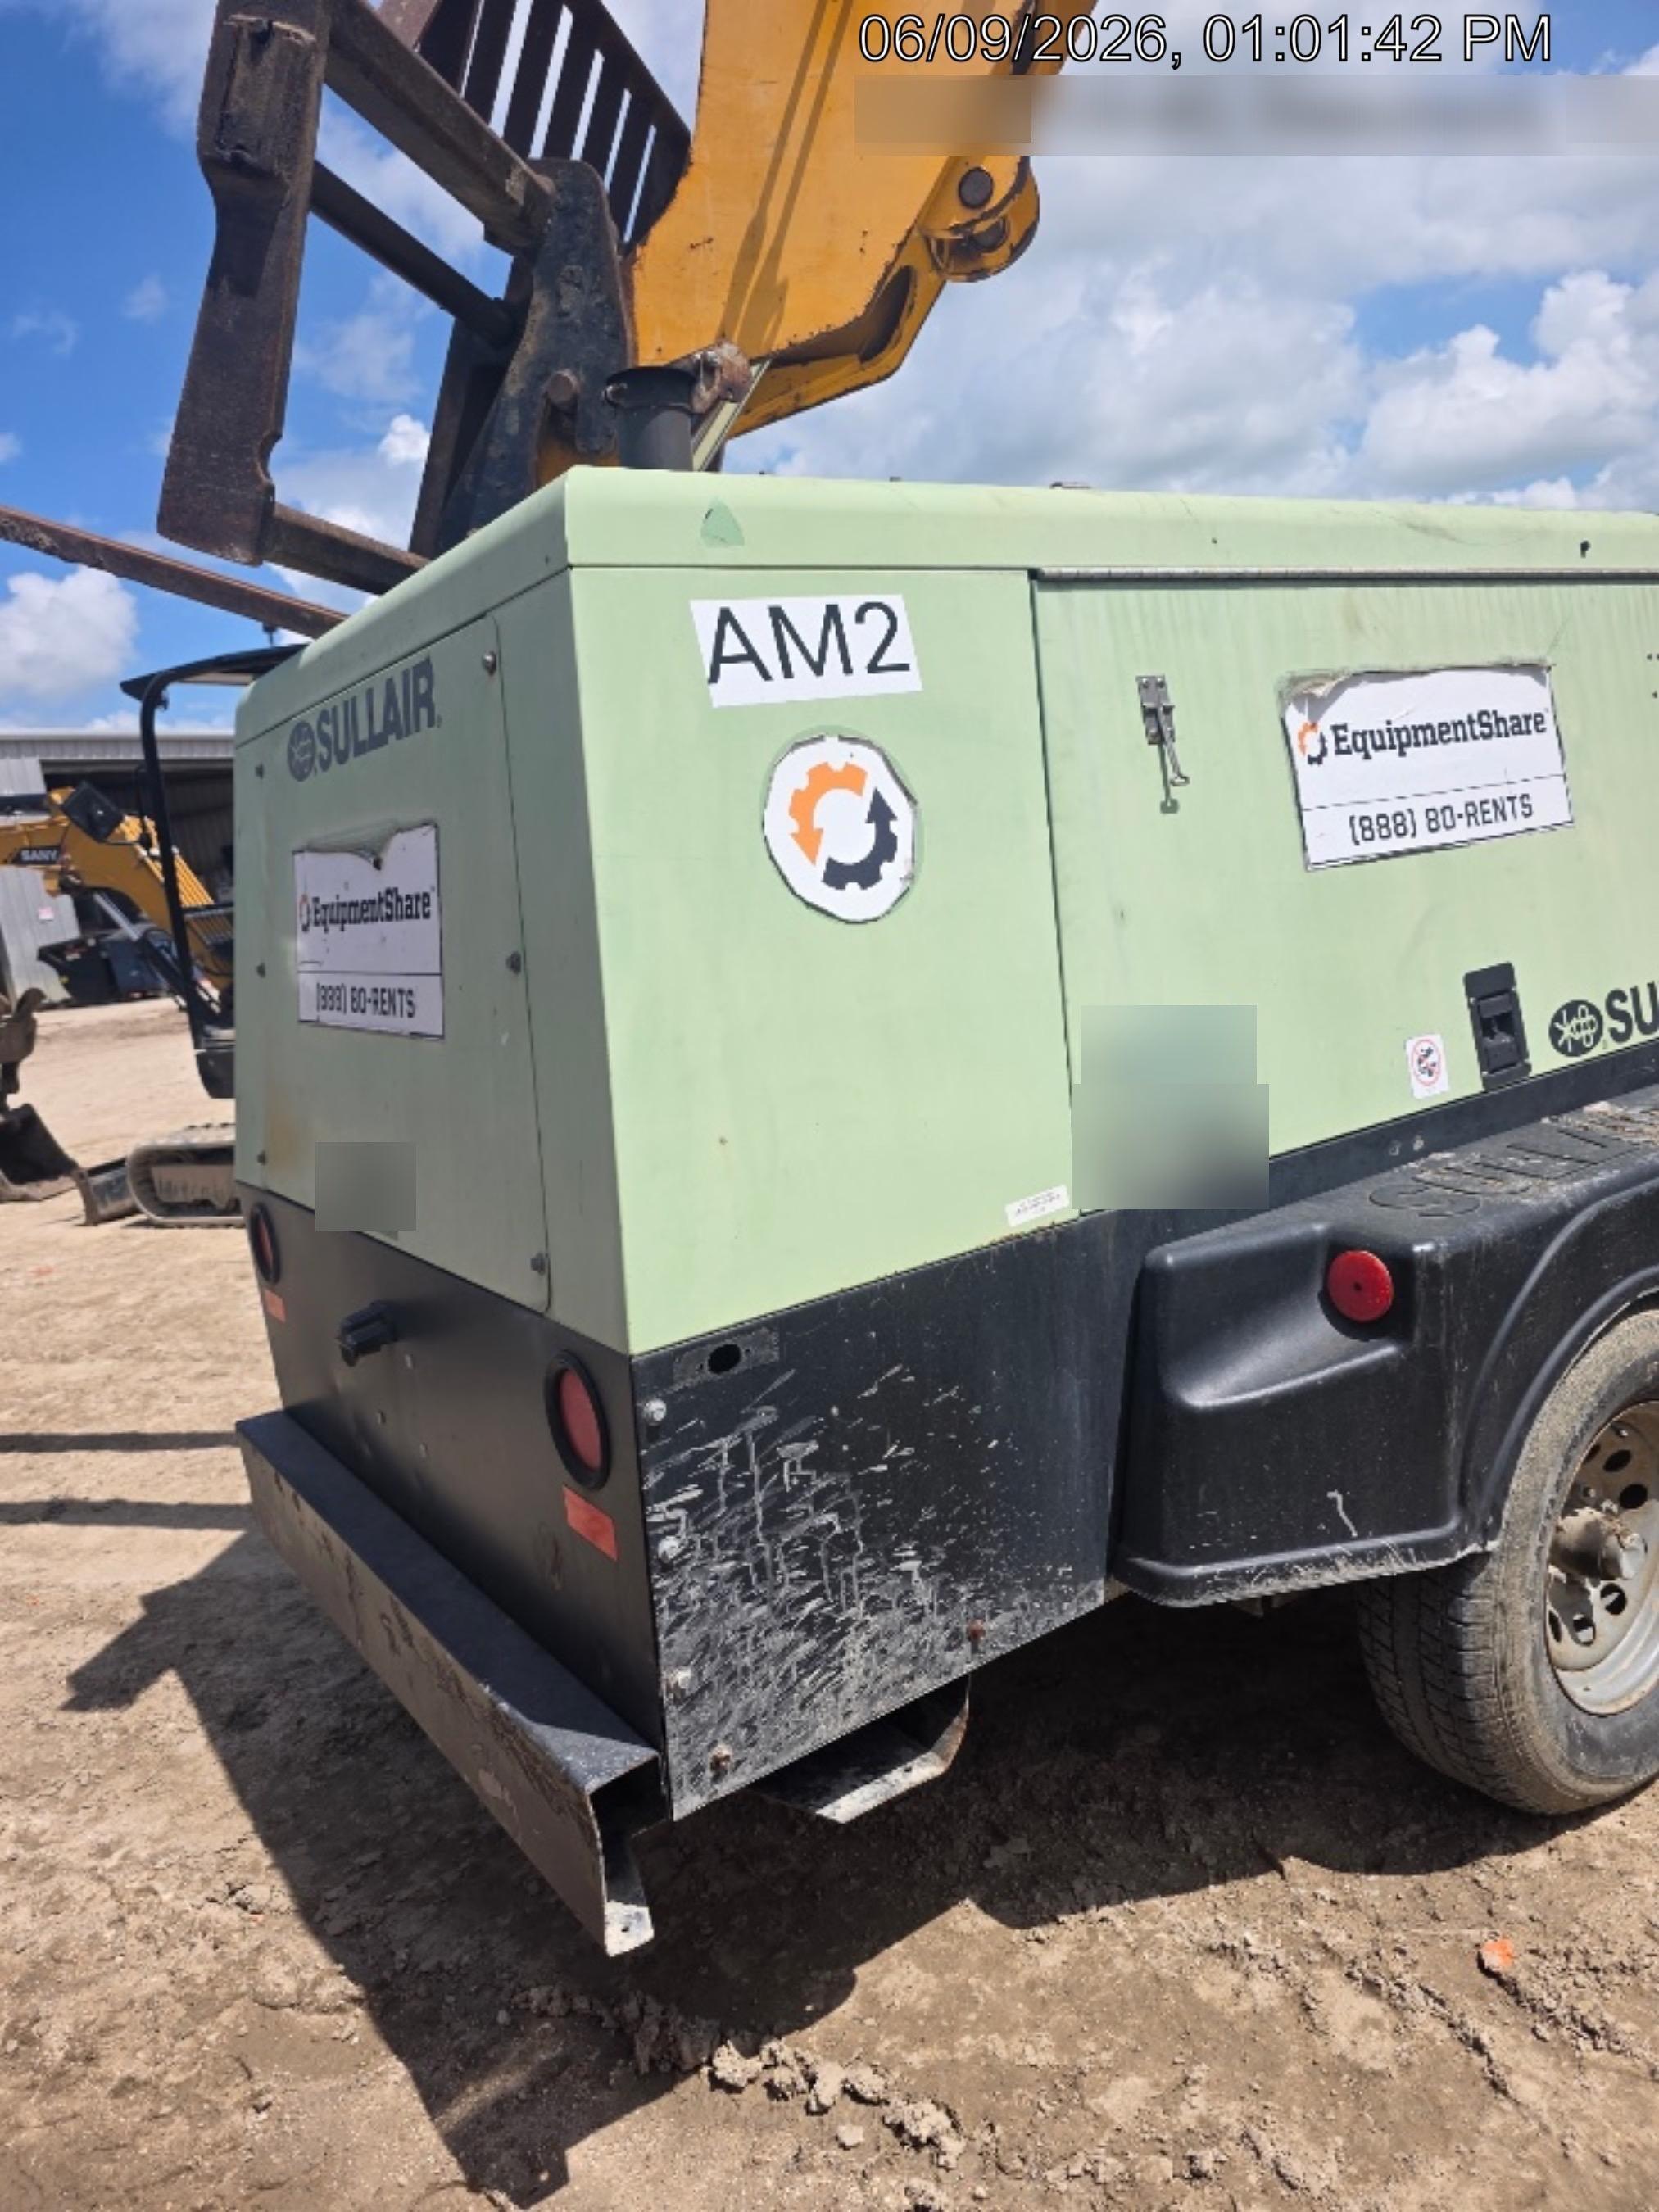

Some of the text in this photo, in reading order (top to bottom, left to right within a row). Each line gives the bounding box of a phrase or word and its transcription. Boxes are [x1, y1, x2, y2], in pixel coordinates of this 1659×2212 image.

[708, 601, 910, 685] AM2
[317, 656, 436, 773] SULLAIR
[1330, 709, 1548, 759] EquipmentShare
[1349, 793, 1533, 845] (888) 80-RENTS
[20, 849, 57, 861] SANY
[312, 886, 431, 934] EquipmentShare
